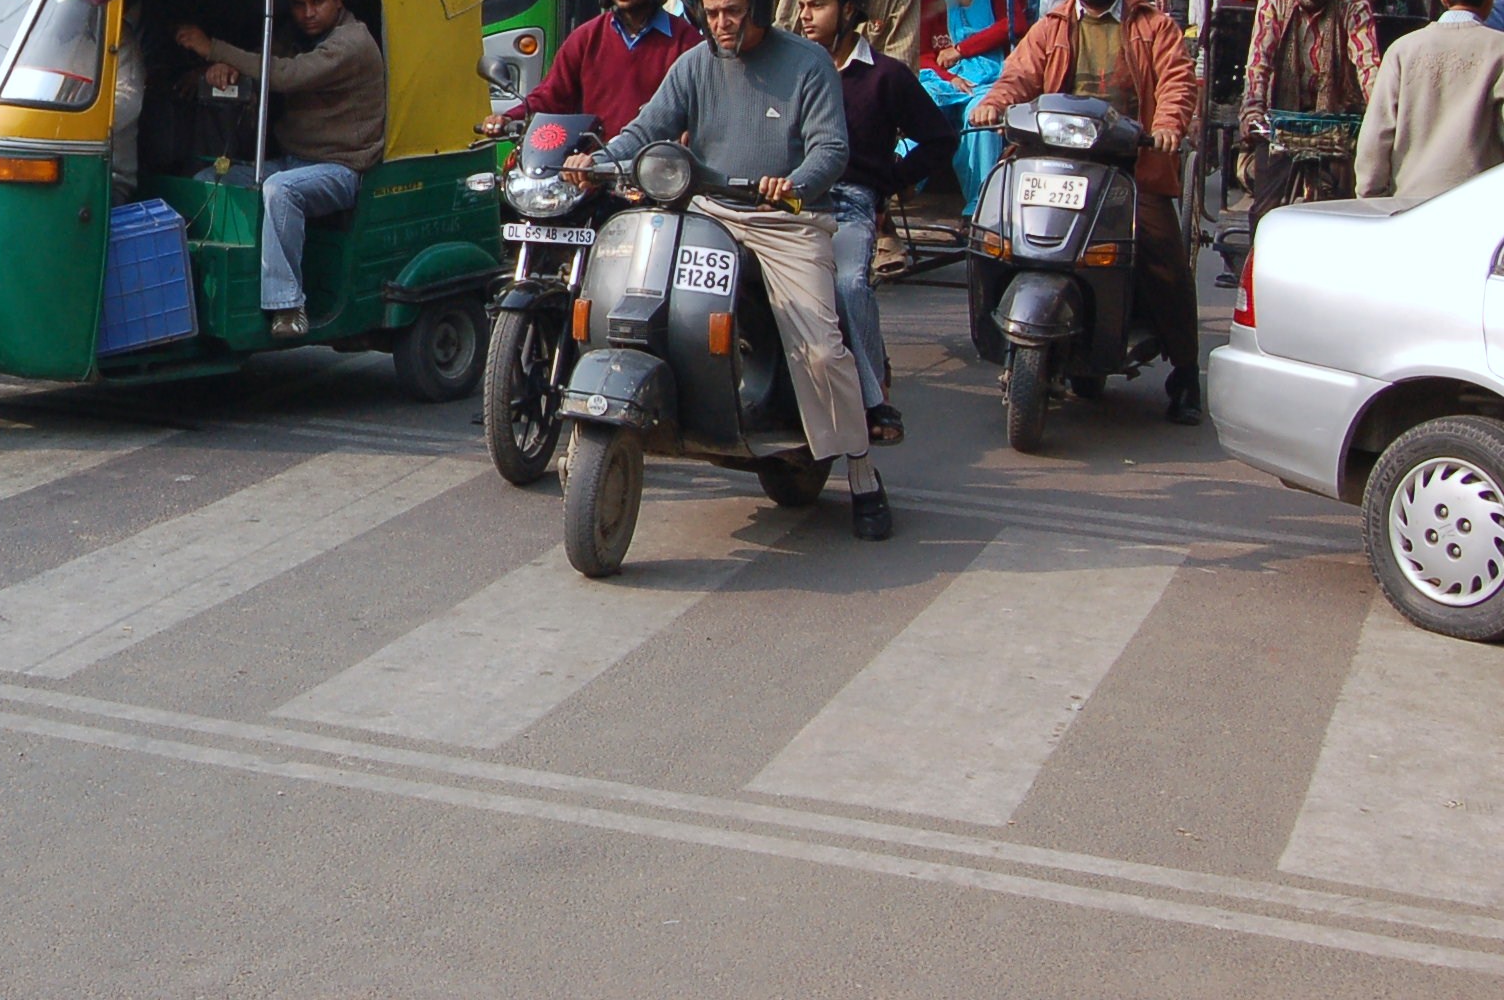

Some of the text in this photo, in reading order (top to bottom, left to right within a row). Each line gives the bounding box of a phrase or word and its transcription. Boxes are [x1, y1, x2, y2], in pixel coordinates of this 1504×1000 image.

[1048, 192, 1080, 206] 2722
[508, 225, 521, 239] DL
[545, 228, 558, 241] AB
